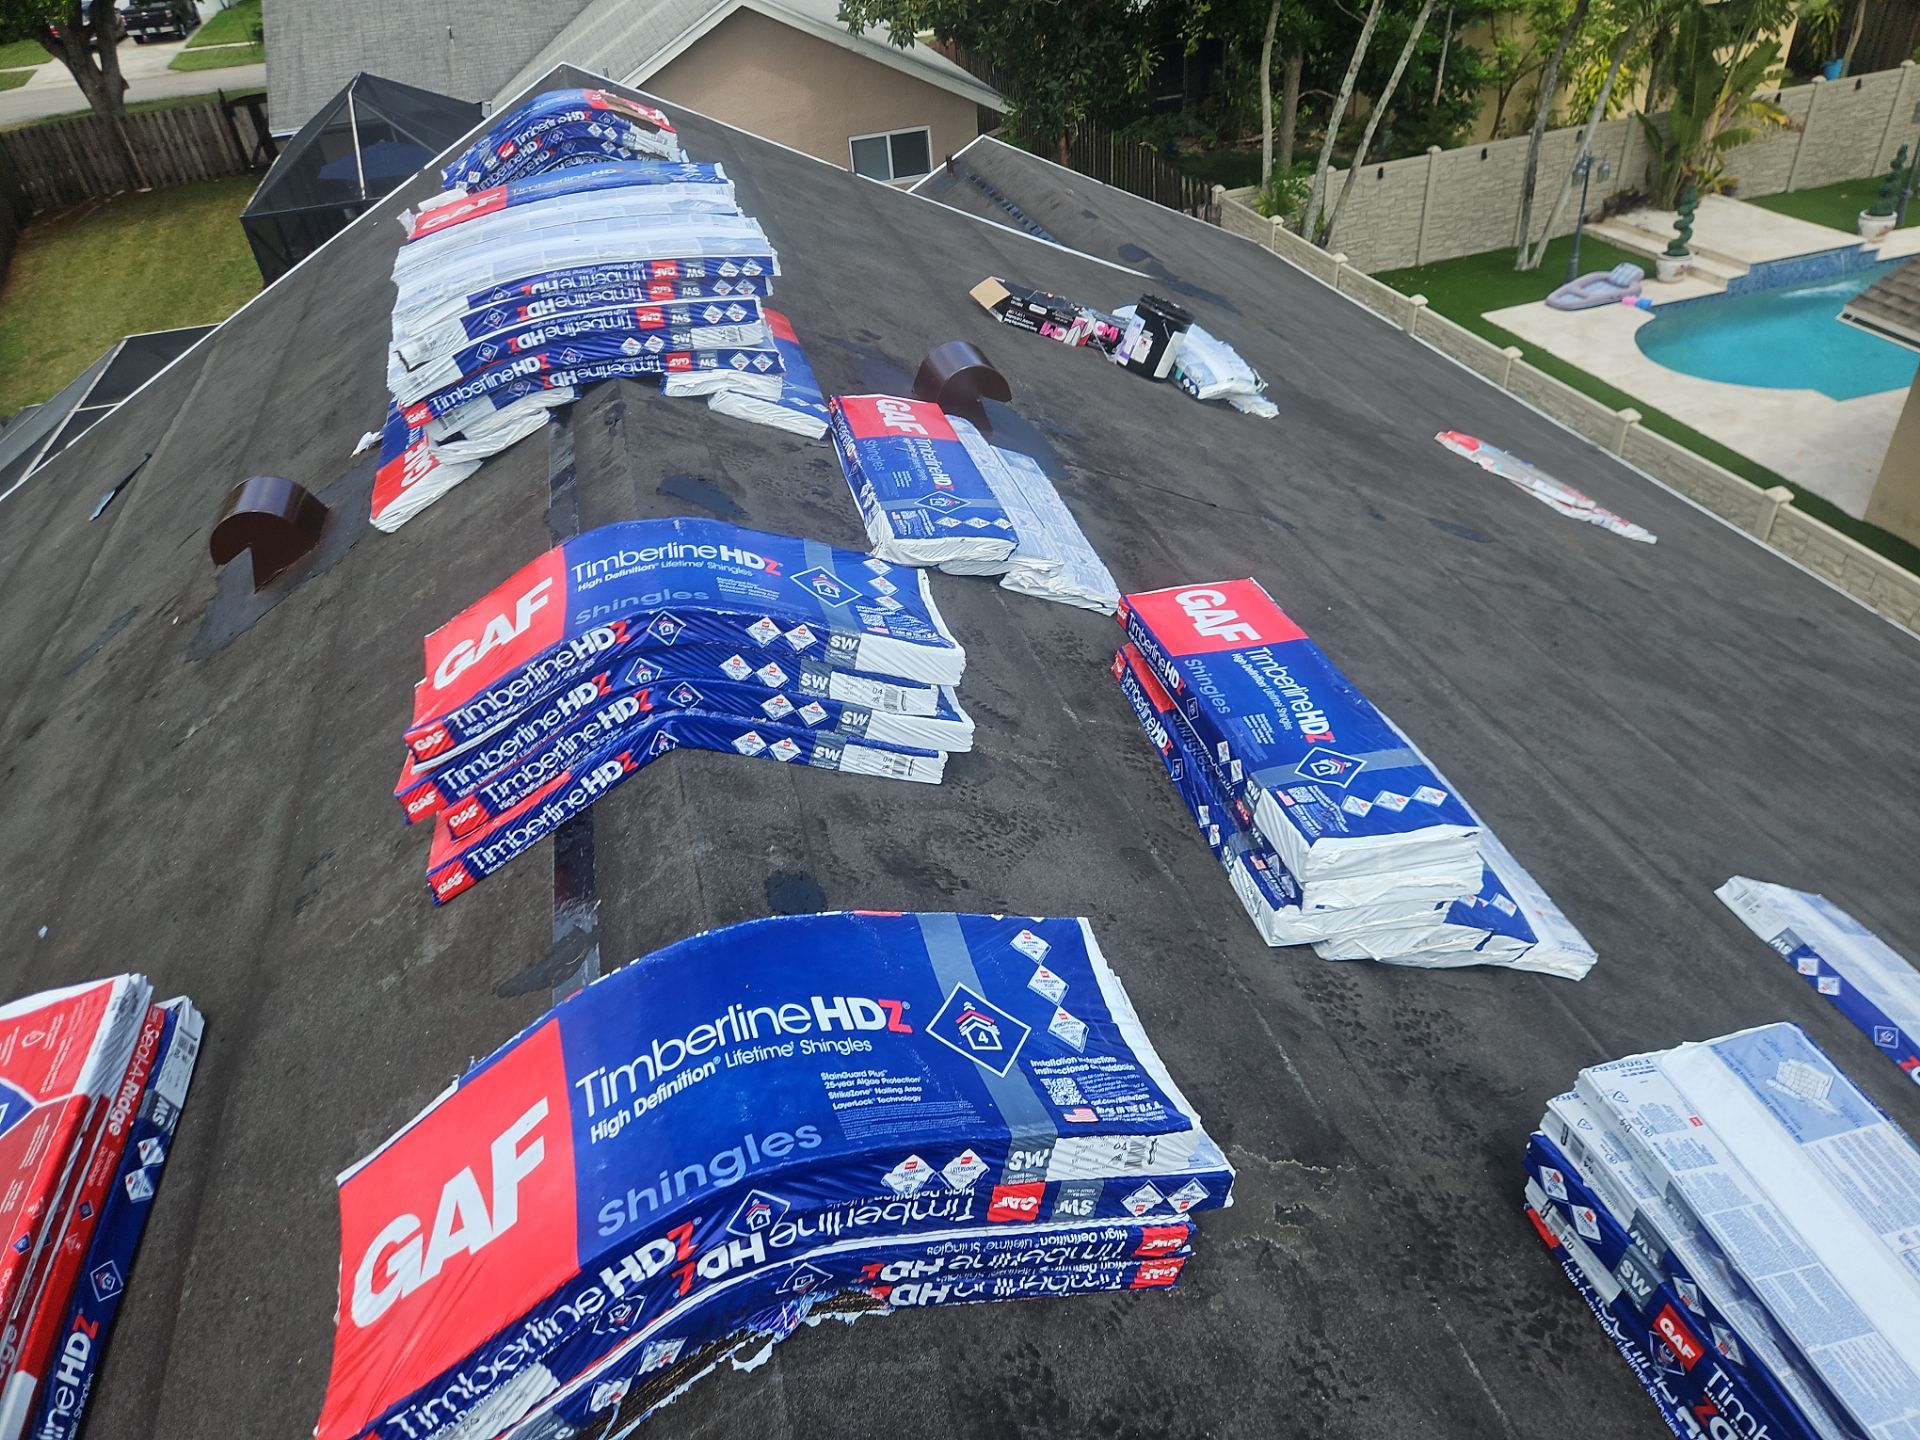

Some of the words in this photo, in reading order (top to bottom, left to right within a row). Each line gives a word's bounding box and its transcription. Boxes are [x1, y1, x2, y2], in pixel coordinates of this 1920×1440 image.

[876, 398, 929, 437] GAF
[576, 575, 598, 592] High
[575, 587, 711, 626] shingles
[1174, 589, 1263, 643] GAF
[433, 577, 553, 691] GAF
[829, 635, 859, 650] SW
[800, 675, 830, 691] SW
[1184, 658, 1231, 715] shingles
[840, 711, 870, 726] SW
[413, 731, 445, 752] GAF
[812, 746, 842, 761] SW
[407, 791, 439, 814] GAF
[977, 1029, 990, 1044] 4
[575, 996, 913, 1118] TimberlineHDZ
[589, 1108, 632, 1144] High
[799, 1036, 873, 1055] Shingles
[1009, 1149, 1050, 1171] SW
[597, 1123, 823, 1238] shingles
[351, 1098, 548, 1329] GAF
[993, 1194, 1038, 1211] GAF
[1055, 1199, 1094, 1217] SW
[1618, 1258, 1651, 1298] SW
[1658, 1316, 1697, 1361] GAF
